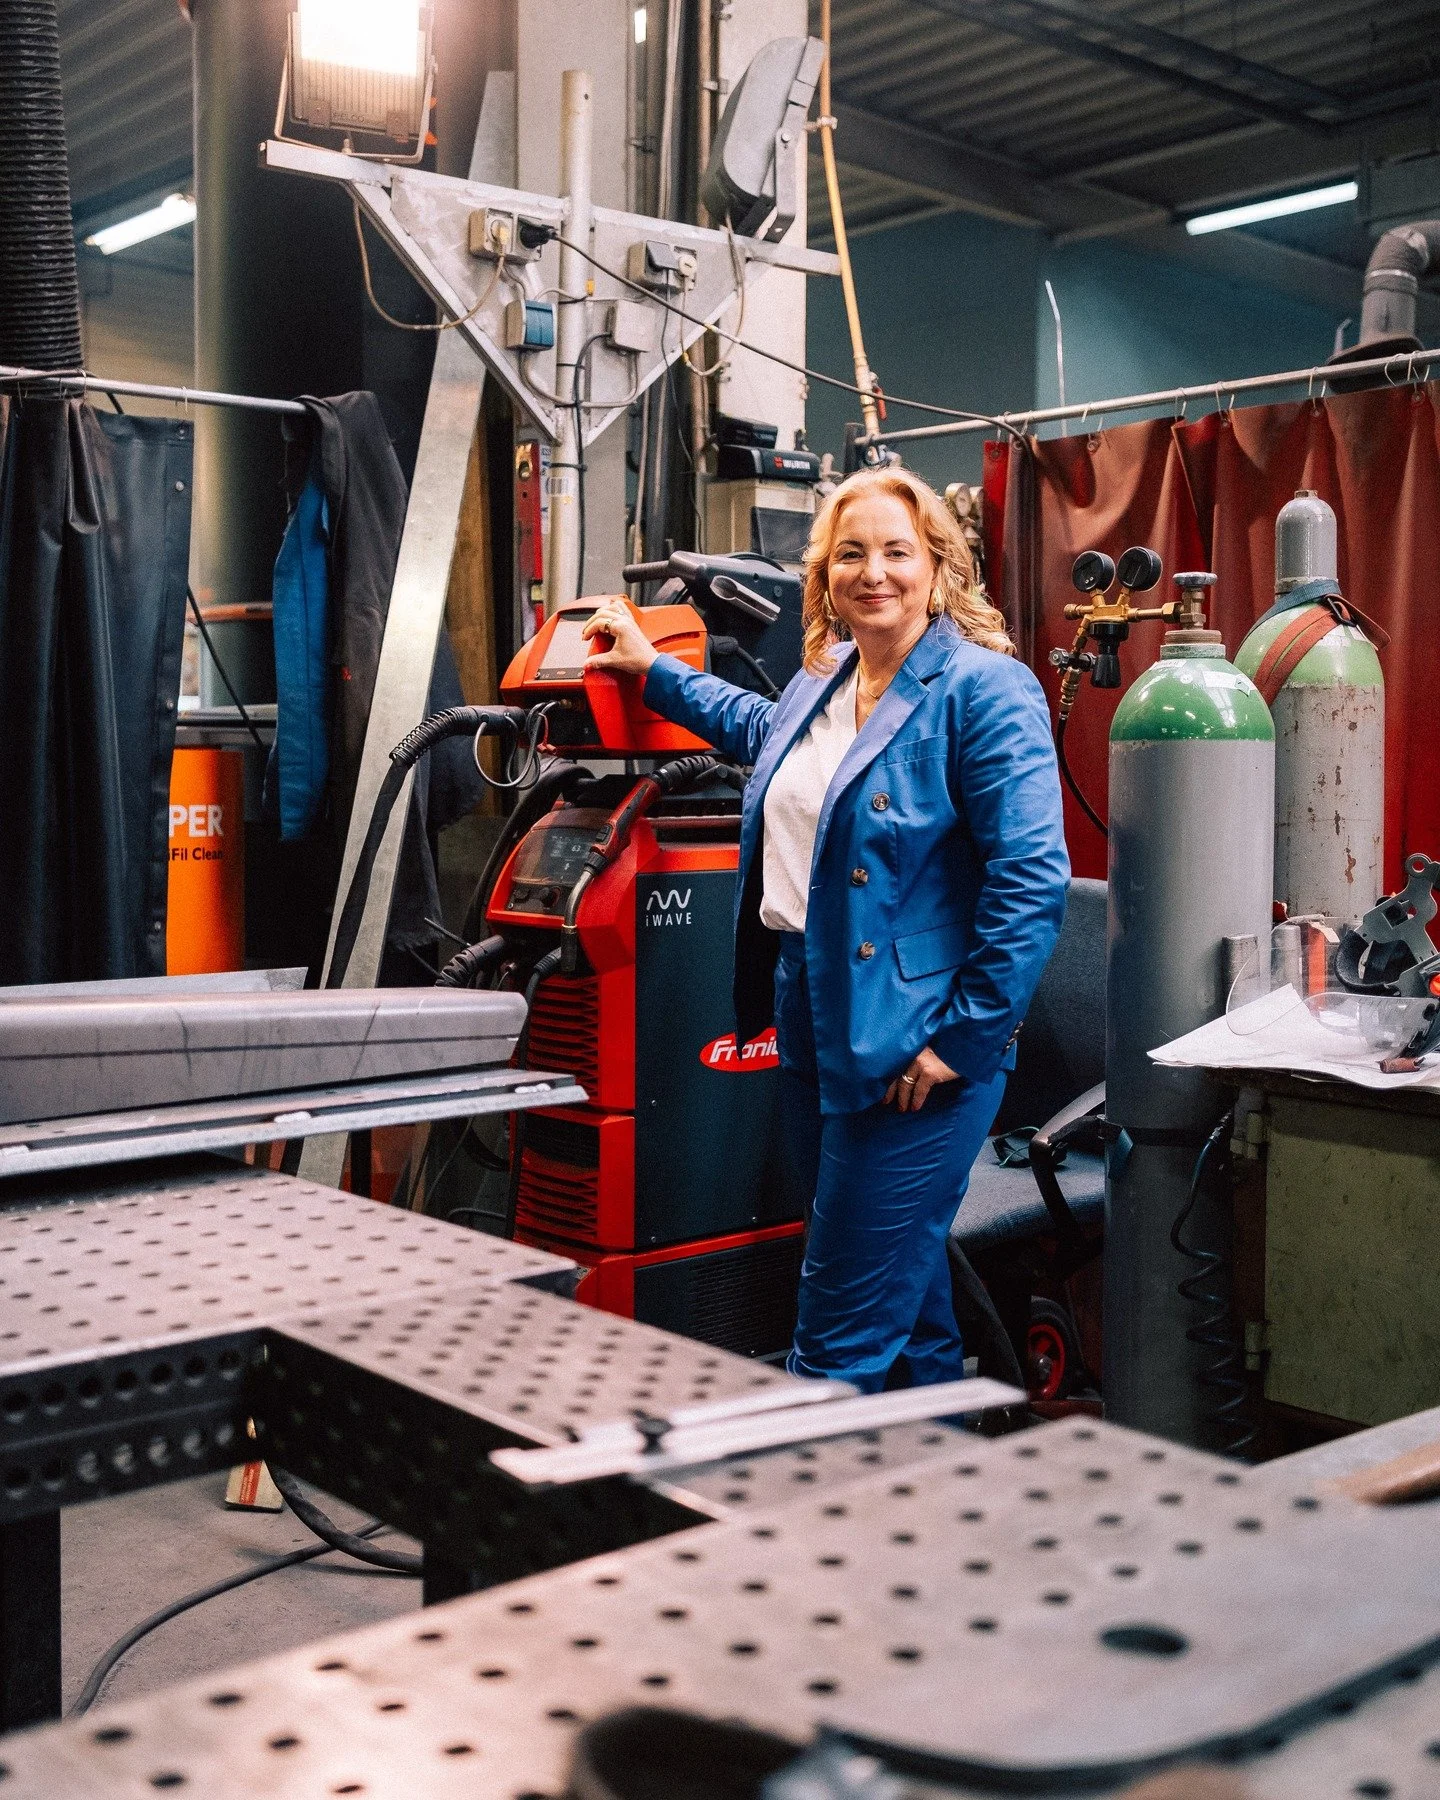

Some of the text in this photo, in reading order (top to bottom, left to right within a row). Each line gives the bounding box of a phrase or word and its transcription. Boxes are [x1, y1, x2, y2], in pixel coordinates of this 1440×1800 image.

[169, 804, 224, 838] PER
[169, 847, 223, 861] Fil Clean
[645, 911, 692, 927] iWAVE
[709, 1036, 779, 1063] Froni
